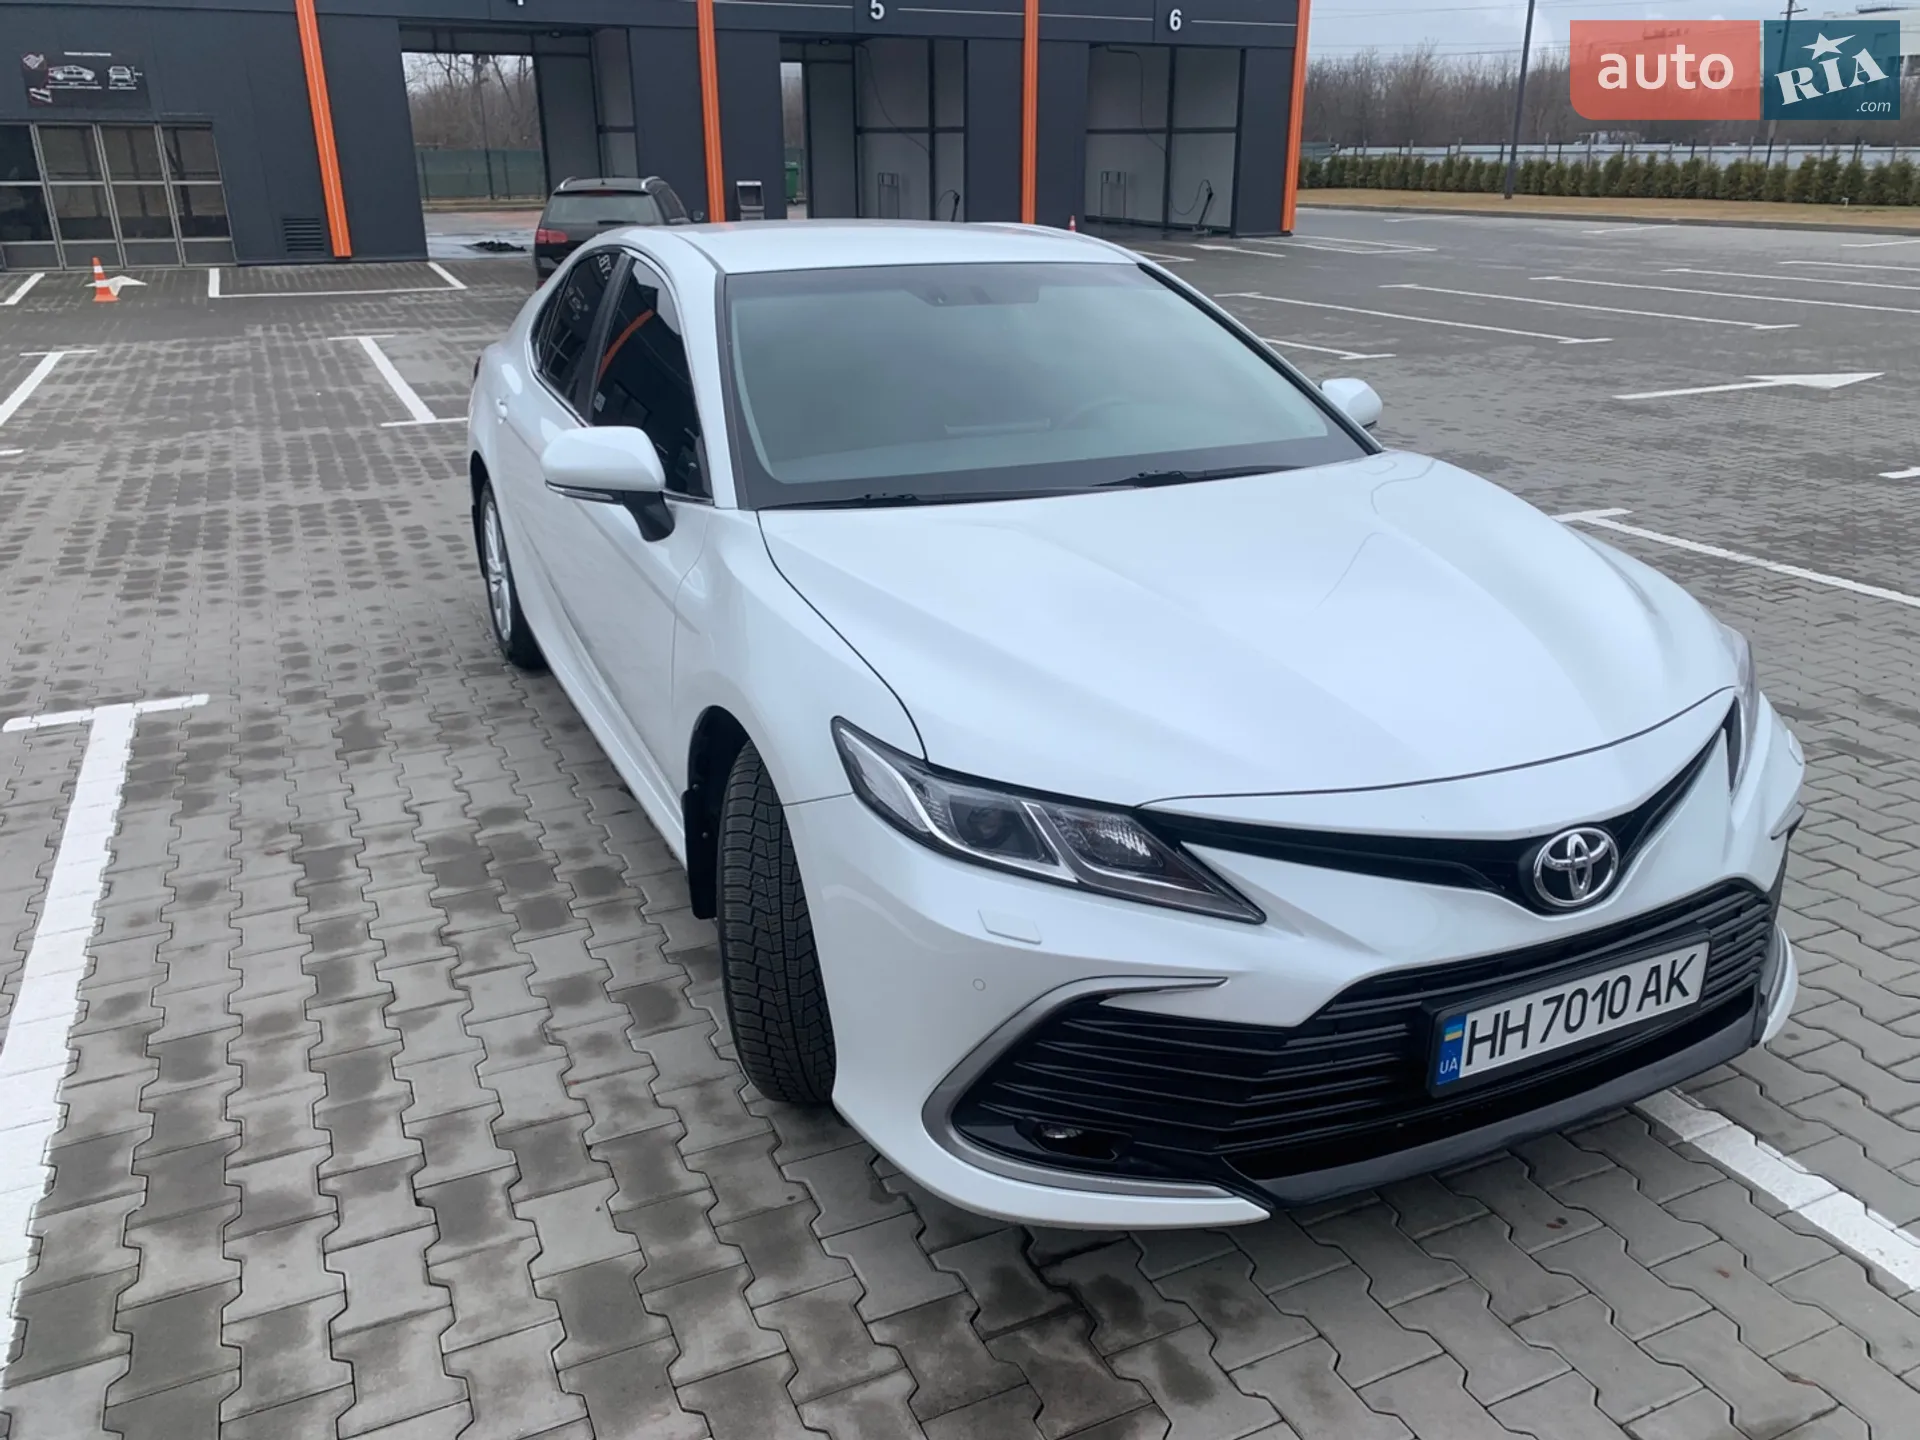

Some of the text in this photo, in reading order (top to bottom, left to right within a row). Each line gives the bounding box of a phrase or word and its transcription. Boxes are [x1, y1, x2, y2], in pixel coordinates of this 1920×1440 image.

[870, 0, 885, 20] 5
[1170, 8, 1182, 31] 6
[1465, 953, 1698, 1067] HH 7010 AK
[1439, 1056, 1459, 1075] UA
